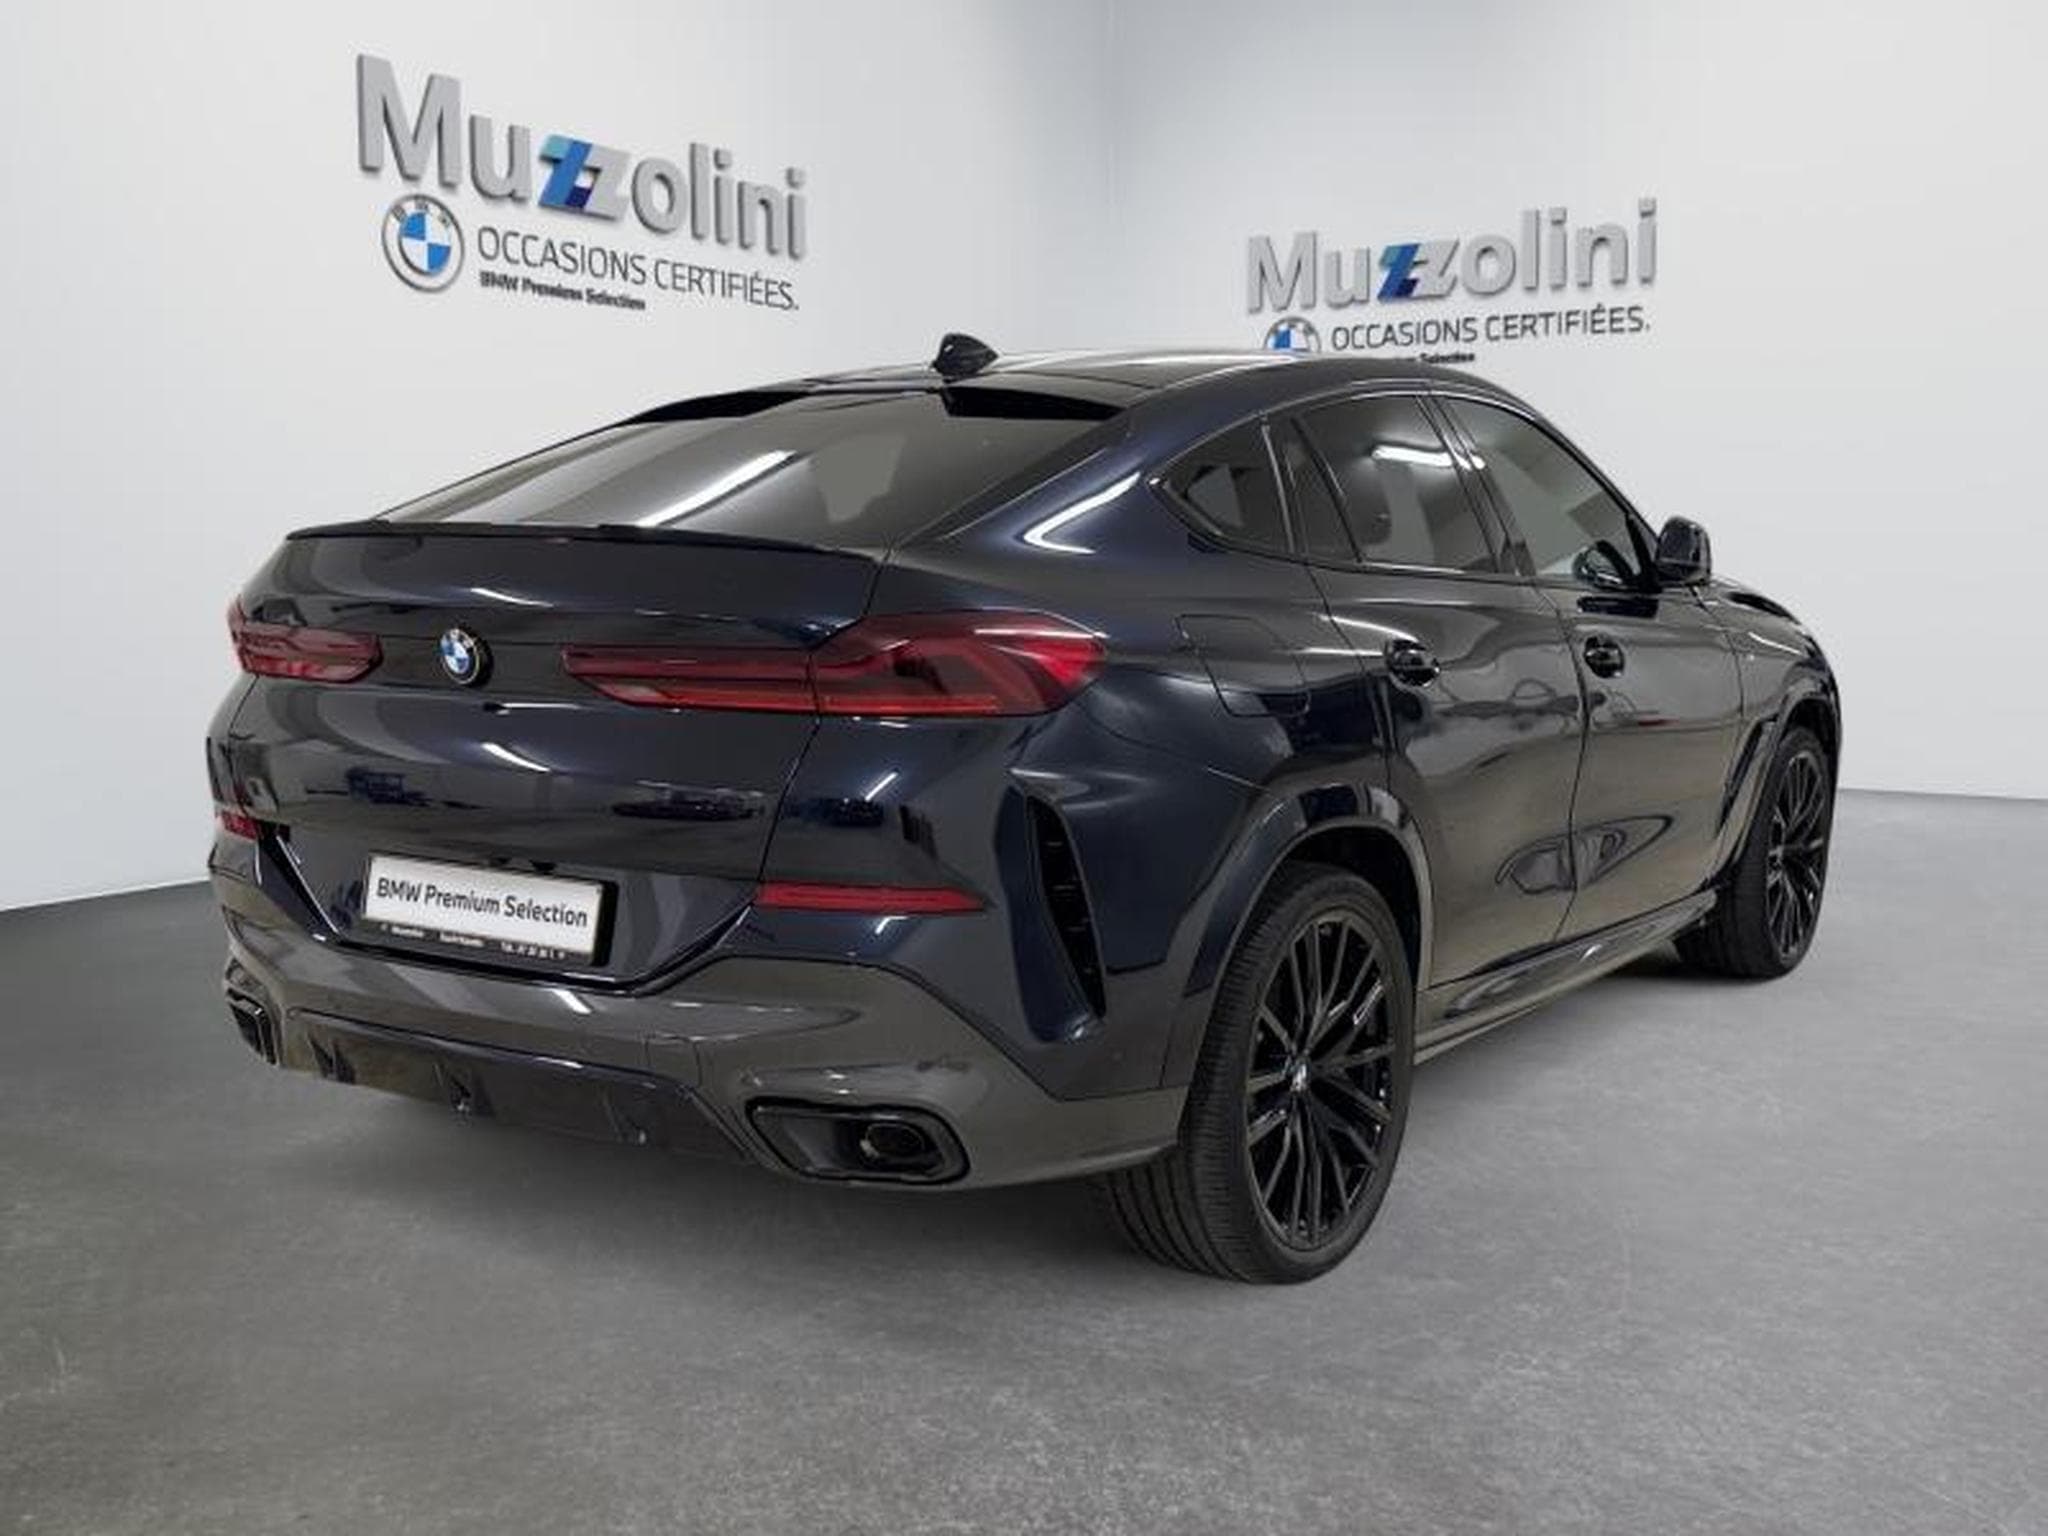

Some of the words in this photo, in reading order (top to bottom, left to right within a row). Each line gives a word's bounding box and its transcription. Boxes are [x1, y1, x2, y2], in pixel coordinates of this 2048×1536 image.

[356, 53, 808, 260] Muzzolini
[477, 226, 647, 285] OCCASIONS
[653, 257, 800, 311] CERTIFIÉES.
[480, 270, 519, 291] BMW
[1246, 197, 1658, 316] Muzzolini
[1331, 317, 1479, 351] OCCASIONS
[1484, 303, 1651, 342] CERTIFIÉES.
[376, 877, 421, 903] BMW
[424, 884, 501, 916] Premium
[504, 894, 589, 928] Selection
